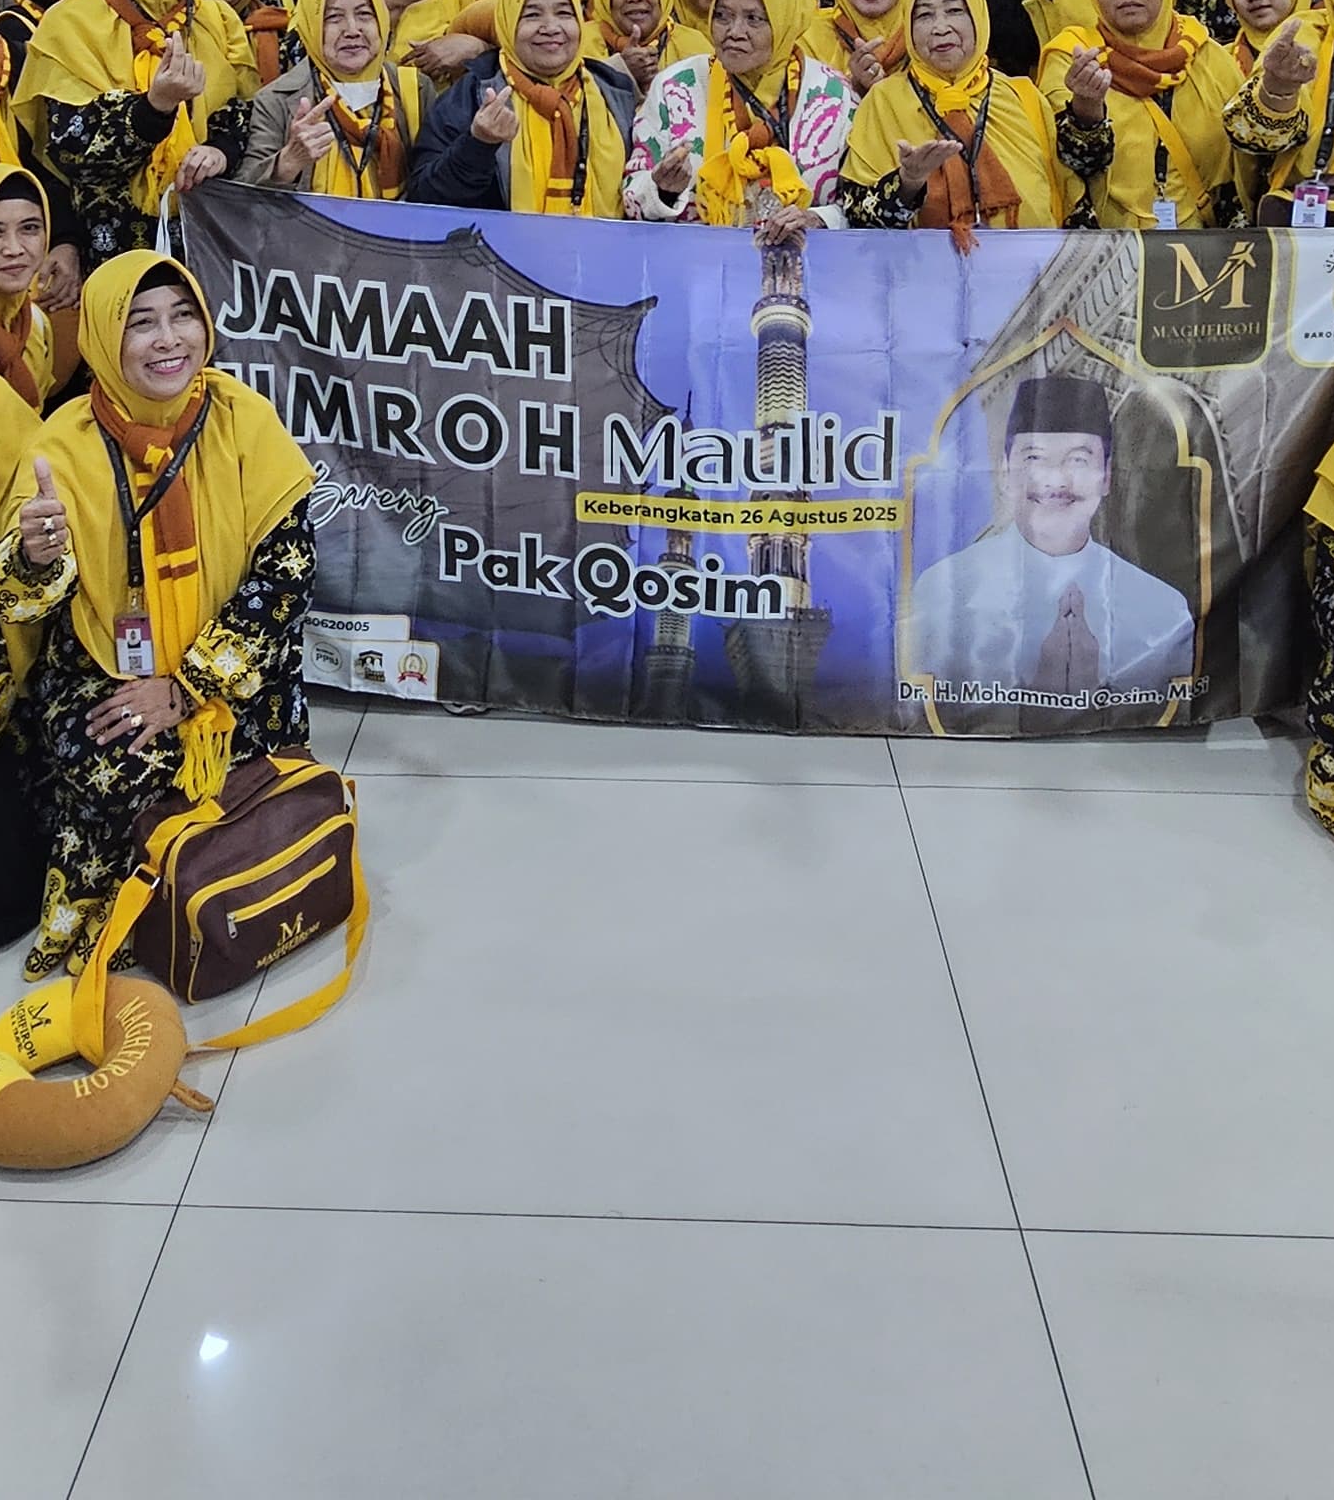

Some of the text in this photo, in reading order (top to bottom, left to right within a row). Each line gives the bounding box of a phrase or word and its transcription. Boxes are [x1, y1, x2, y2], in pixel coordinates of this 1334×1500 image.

[215, 259, 572, 382] JAMAAH
[603, 409, 901, 492] Maulid
[307, 458, 450, 546] Bareng
[583, 500, 898, 527] Keberangkatan 26 Agustus 2025
[439, 522, 786, 620] Pak Qosim
[899, 681, 929, 701] Dr.
[934, 681, 958, 702] H.
[960, 681, 1088, 710] Mohammad
[73, 996, 153, 1099] MAGHFIROH
